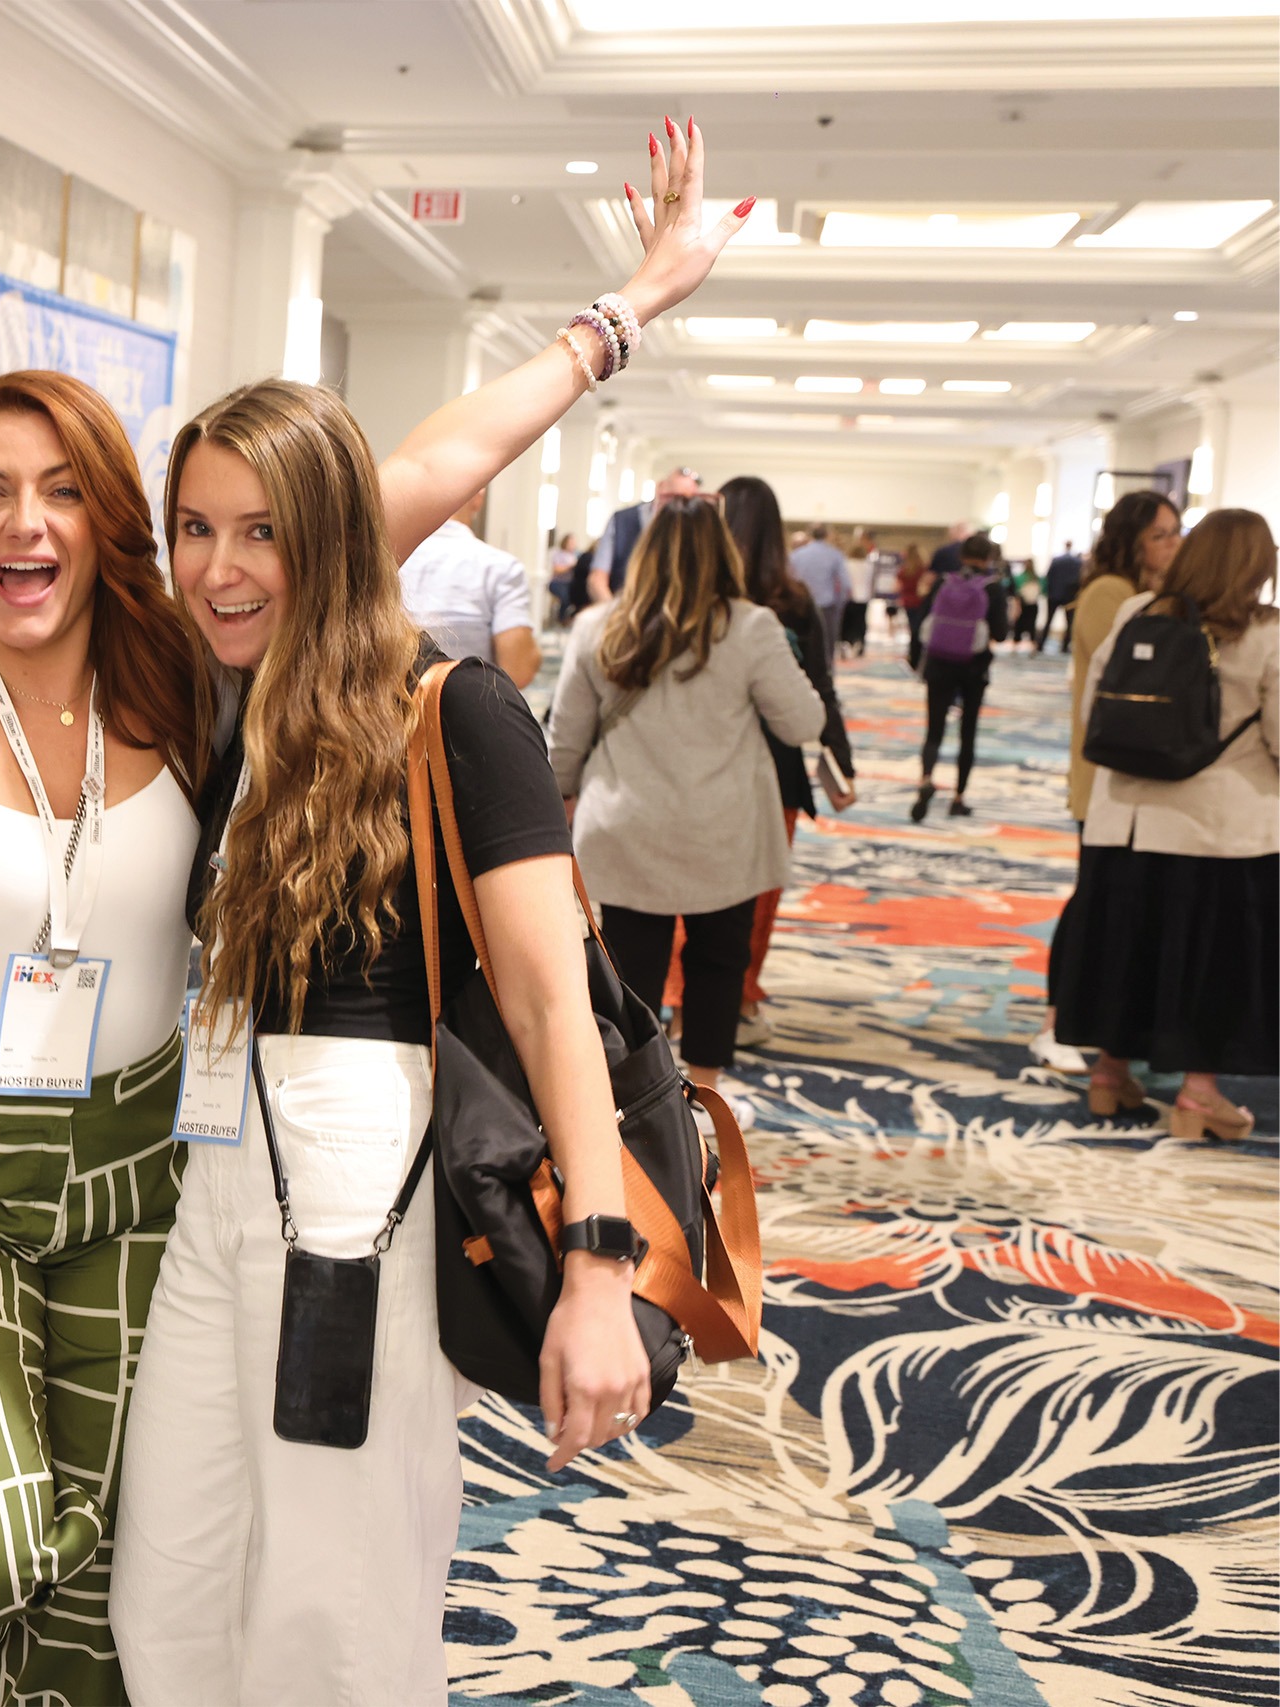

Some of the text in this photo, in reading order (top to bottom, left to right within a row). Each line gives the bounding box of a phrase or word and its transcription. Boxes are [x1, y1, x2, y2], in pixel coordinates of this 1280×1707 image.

[0, 1075, 83, 1089] HOSTED BUYER
[178, 1121, 238, 1138] HOSTED BUYER
